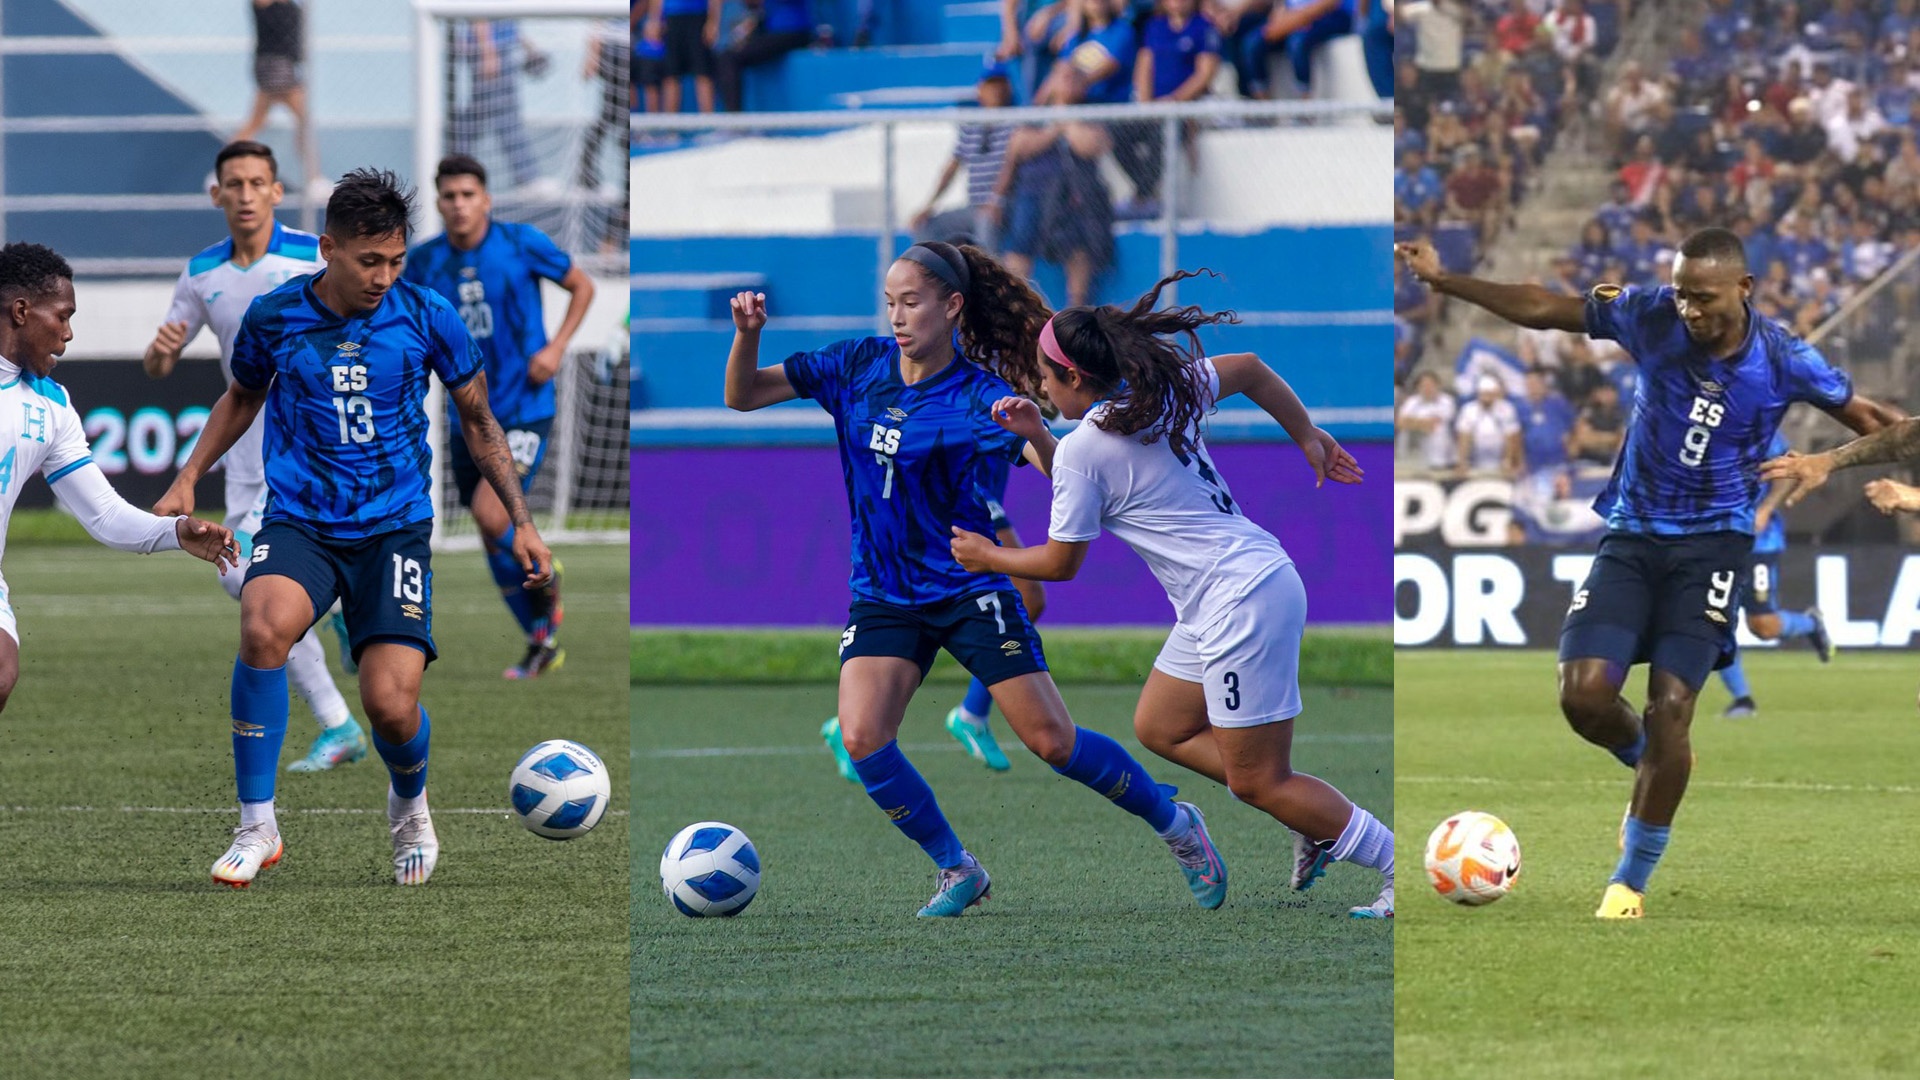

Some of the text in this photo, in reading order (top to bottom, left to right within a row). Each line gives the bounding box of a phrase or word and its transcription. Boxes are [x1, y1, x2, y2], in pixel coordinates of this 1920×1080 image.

[331, 365, 368, 392] ES
[21, 402, 46, 443] H
[332, 396, 375, 444] 13
[1688, 396, 1725, 428] ES
[506, 429, 541, 466] 20
[869, 423, 902, 455] ES
[1679, 425, 1711, 467] 9
[875, 452, 894, 499] 7
[251, 543, 270, 563] S
[393, 553, 423, 604] 13
[1754, 563, 1769, 591] 8
[976, 591, 1006, 634] 7
[838, 624, 857, 657] S
[1223, 671, 1240, 711] 3
